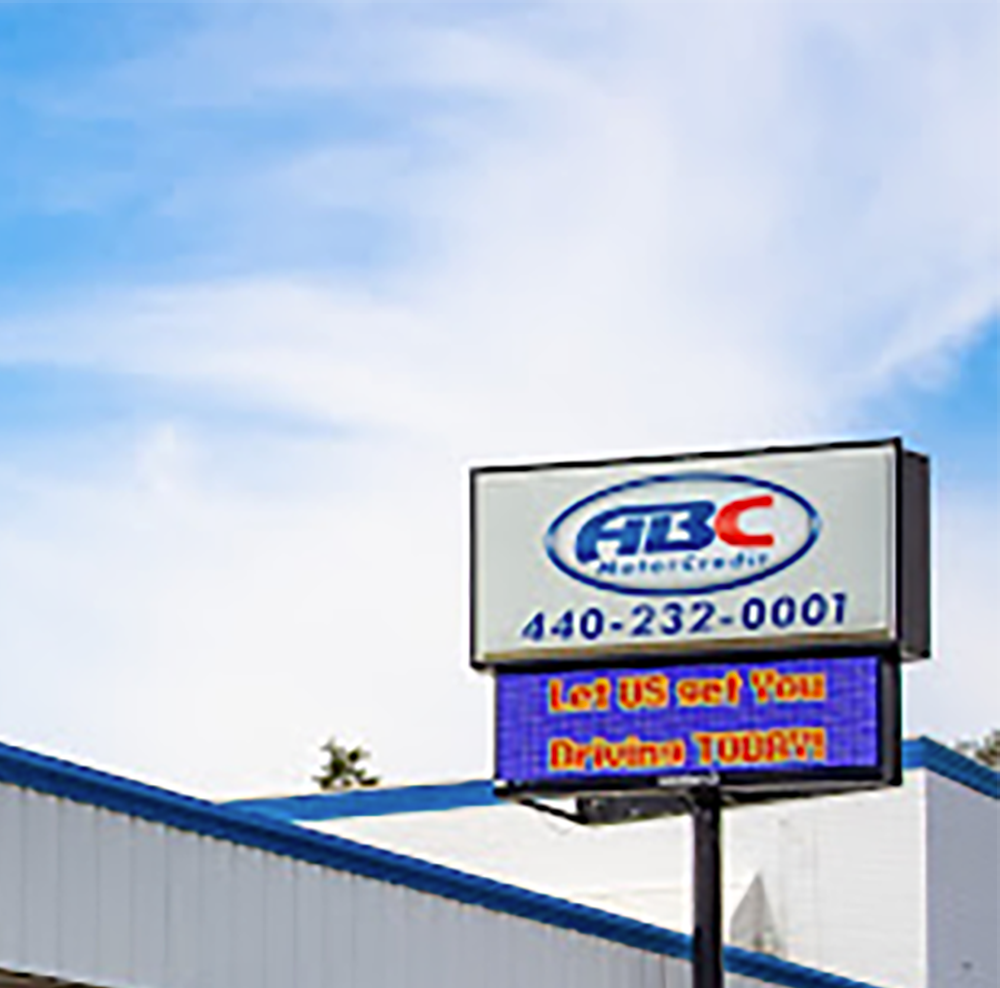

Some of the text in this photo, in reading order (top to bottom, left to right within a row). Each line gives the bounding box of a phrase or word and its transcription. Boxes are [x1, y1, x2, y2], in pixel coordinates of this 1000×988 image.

[575, 494, 775, 564] ABC
[521, 592, 847, 641] 440-232-0001
[549, 678, 611, 712] Let
[617, 674, 669, 711] US
[749, 668, 826, 704] You
[691, 727, 826, 765] TODAY!
